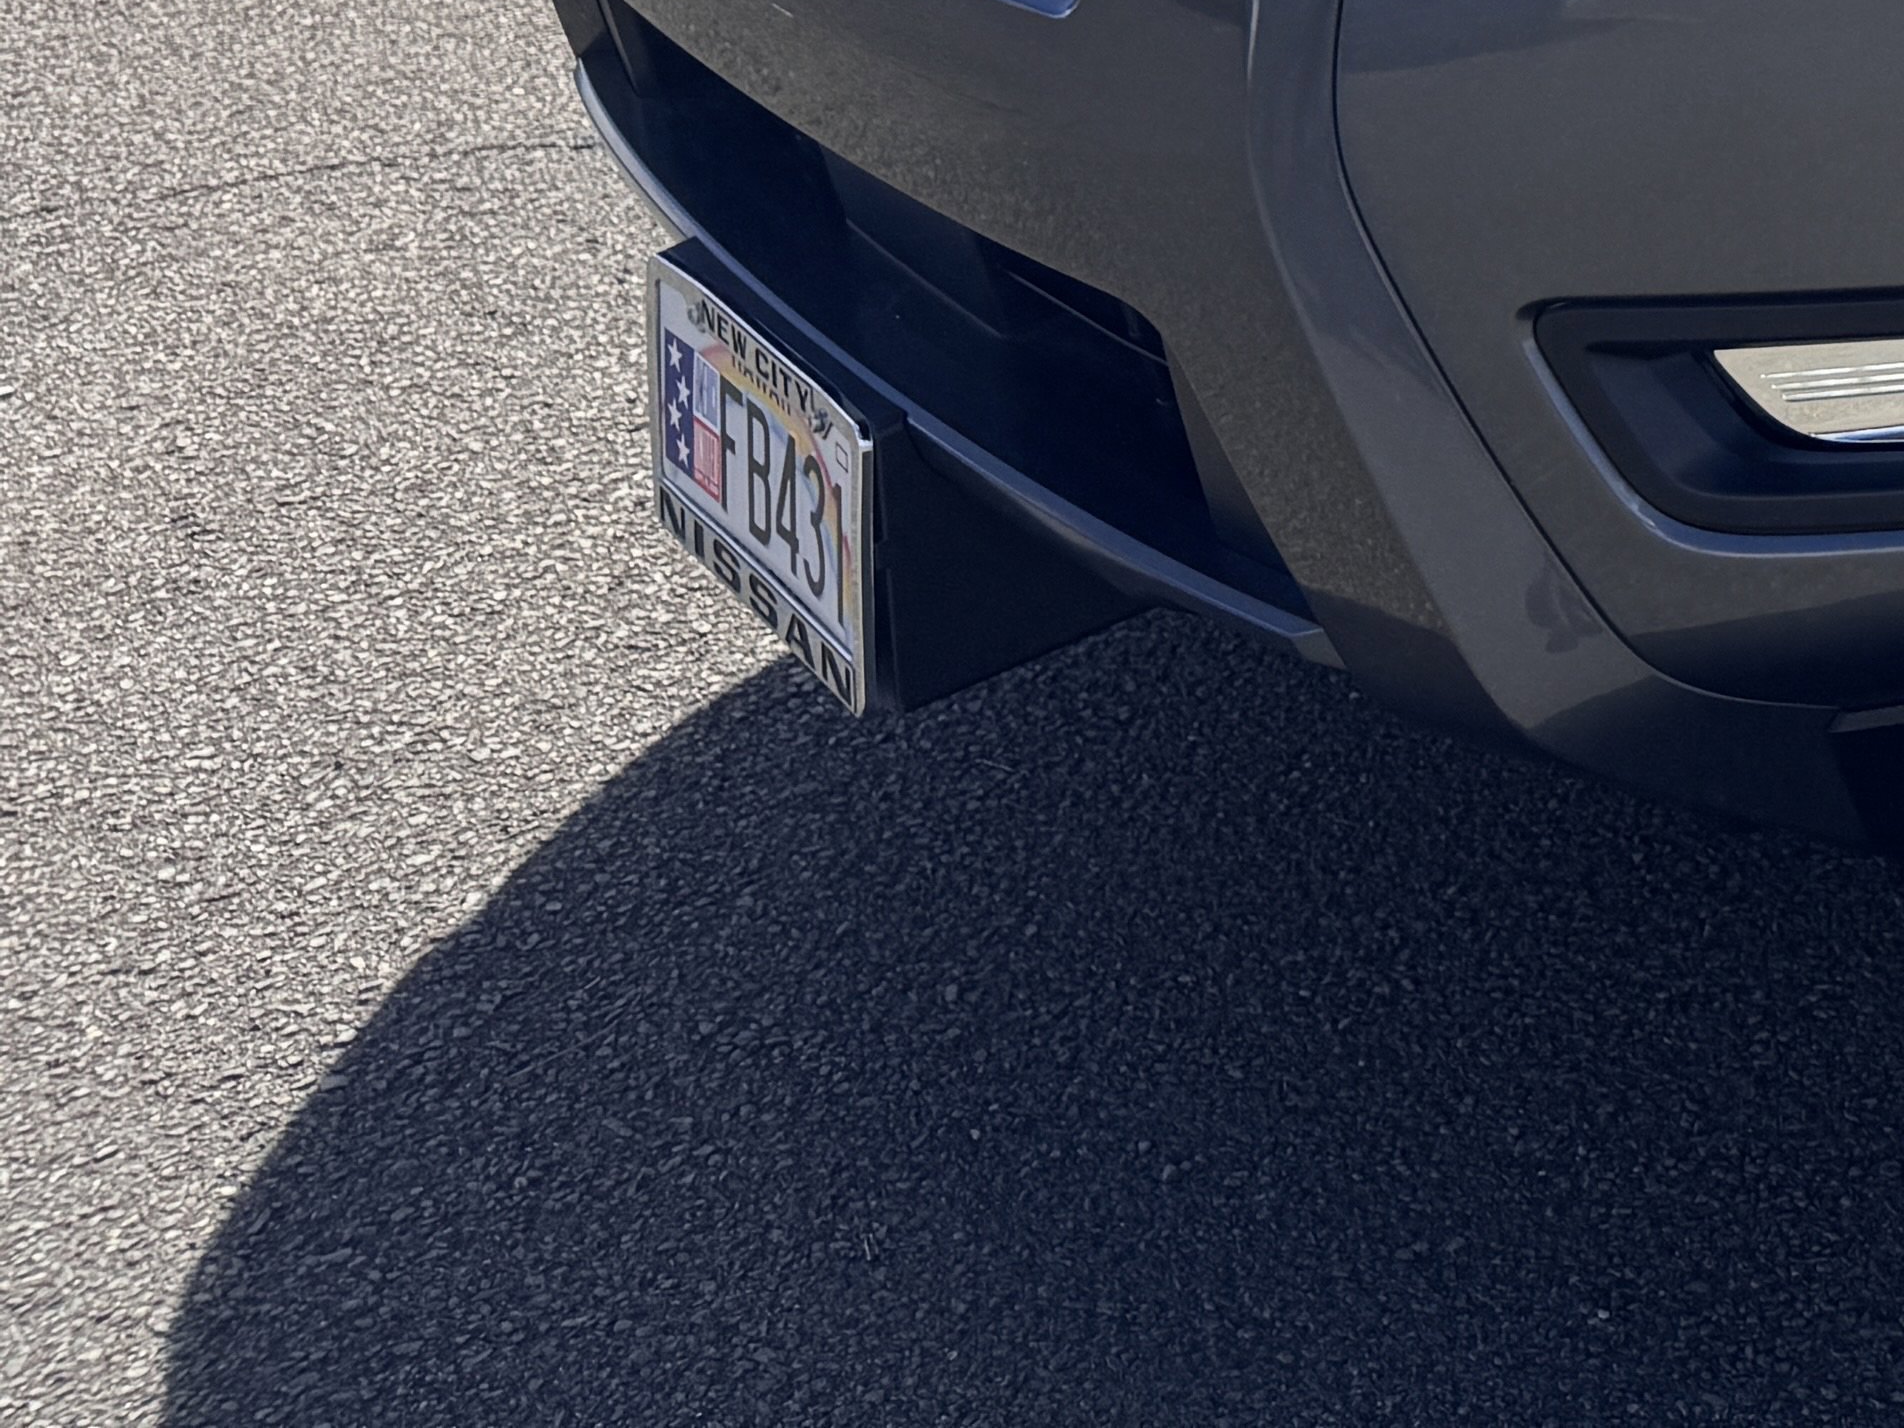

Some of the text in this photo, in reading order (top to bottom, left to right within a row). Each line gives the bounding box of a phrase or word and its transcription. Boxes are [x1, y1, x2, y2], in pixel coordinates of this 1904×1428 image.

[701, 298, 747, 361] NEW
[755, 347, 809, 413] CITY
[659, 485, 853, 707] NISSAN
